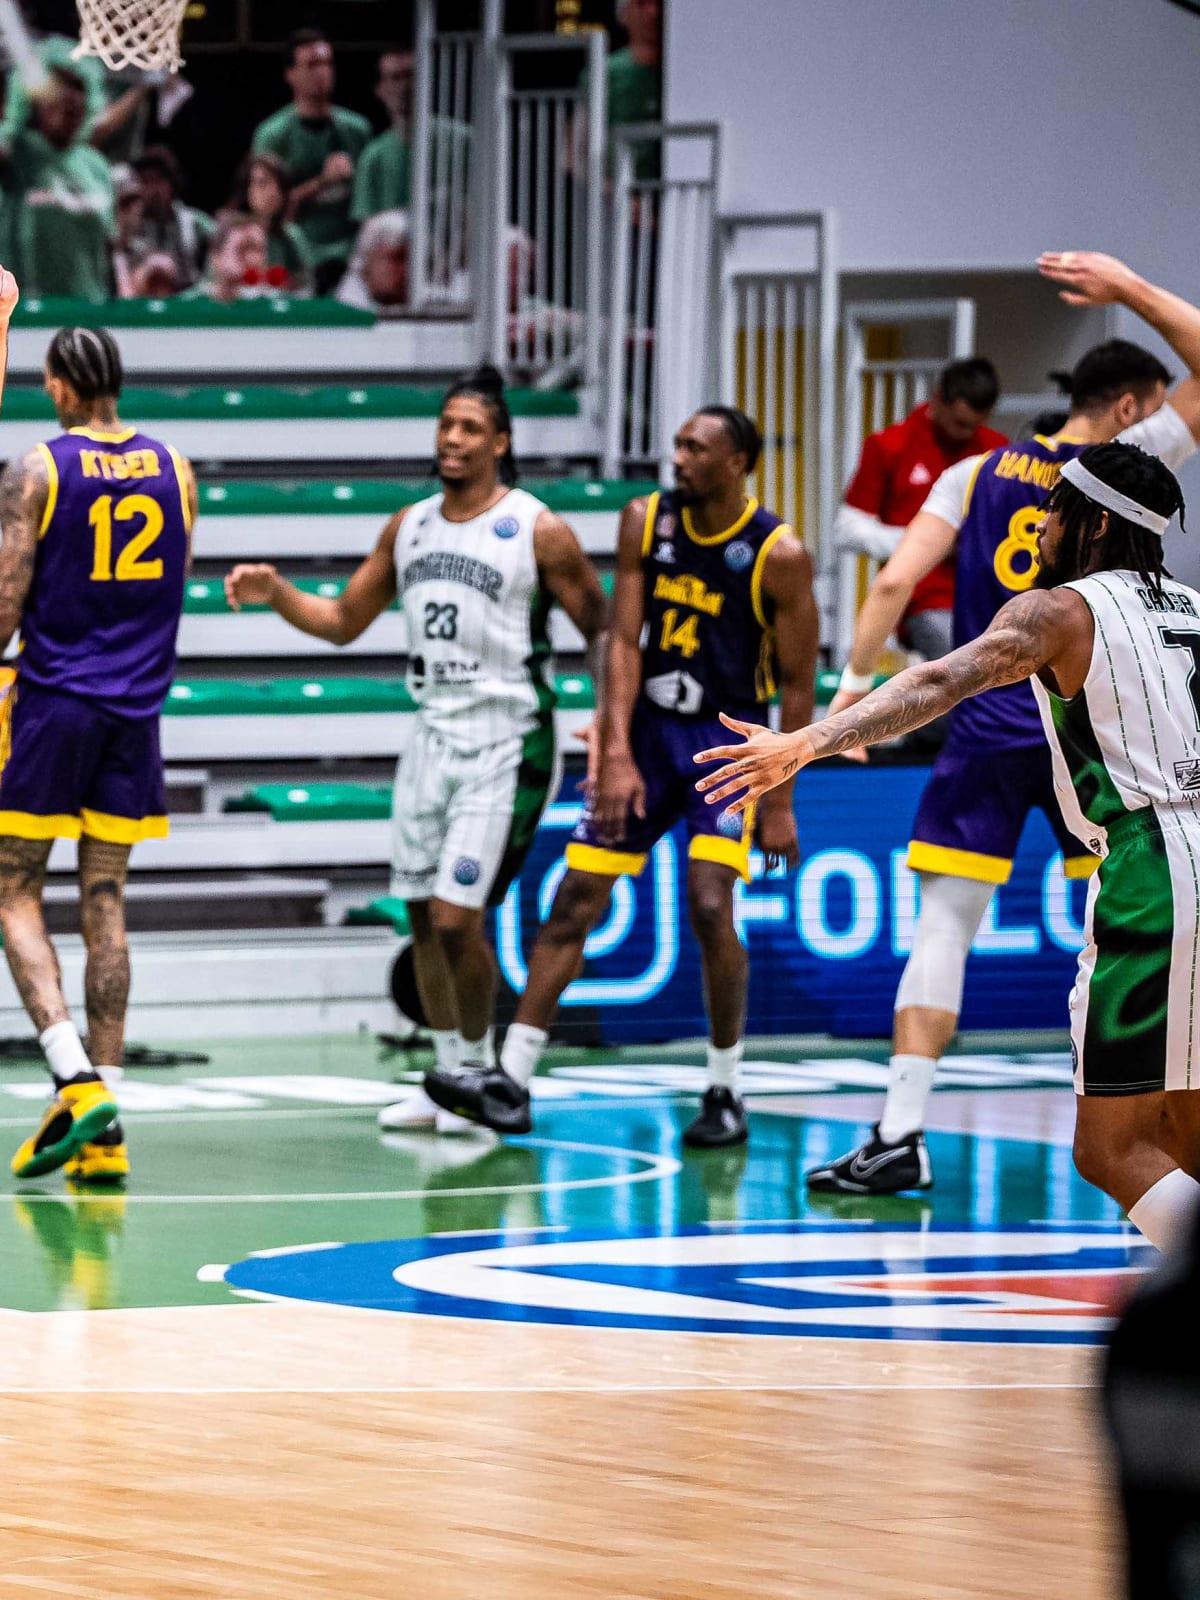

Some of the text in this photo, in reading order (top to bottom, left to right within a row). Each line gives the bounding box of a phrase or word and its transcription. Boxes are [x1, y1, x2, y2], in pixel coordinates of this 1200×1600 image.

[79, 448, 161, 479] KYSER
[88, 494, 164, 581] 12
[994, 505, 1049, 591] 8
[424, 602, 458, 640] 23
[659, 608, 700, 659] 14
